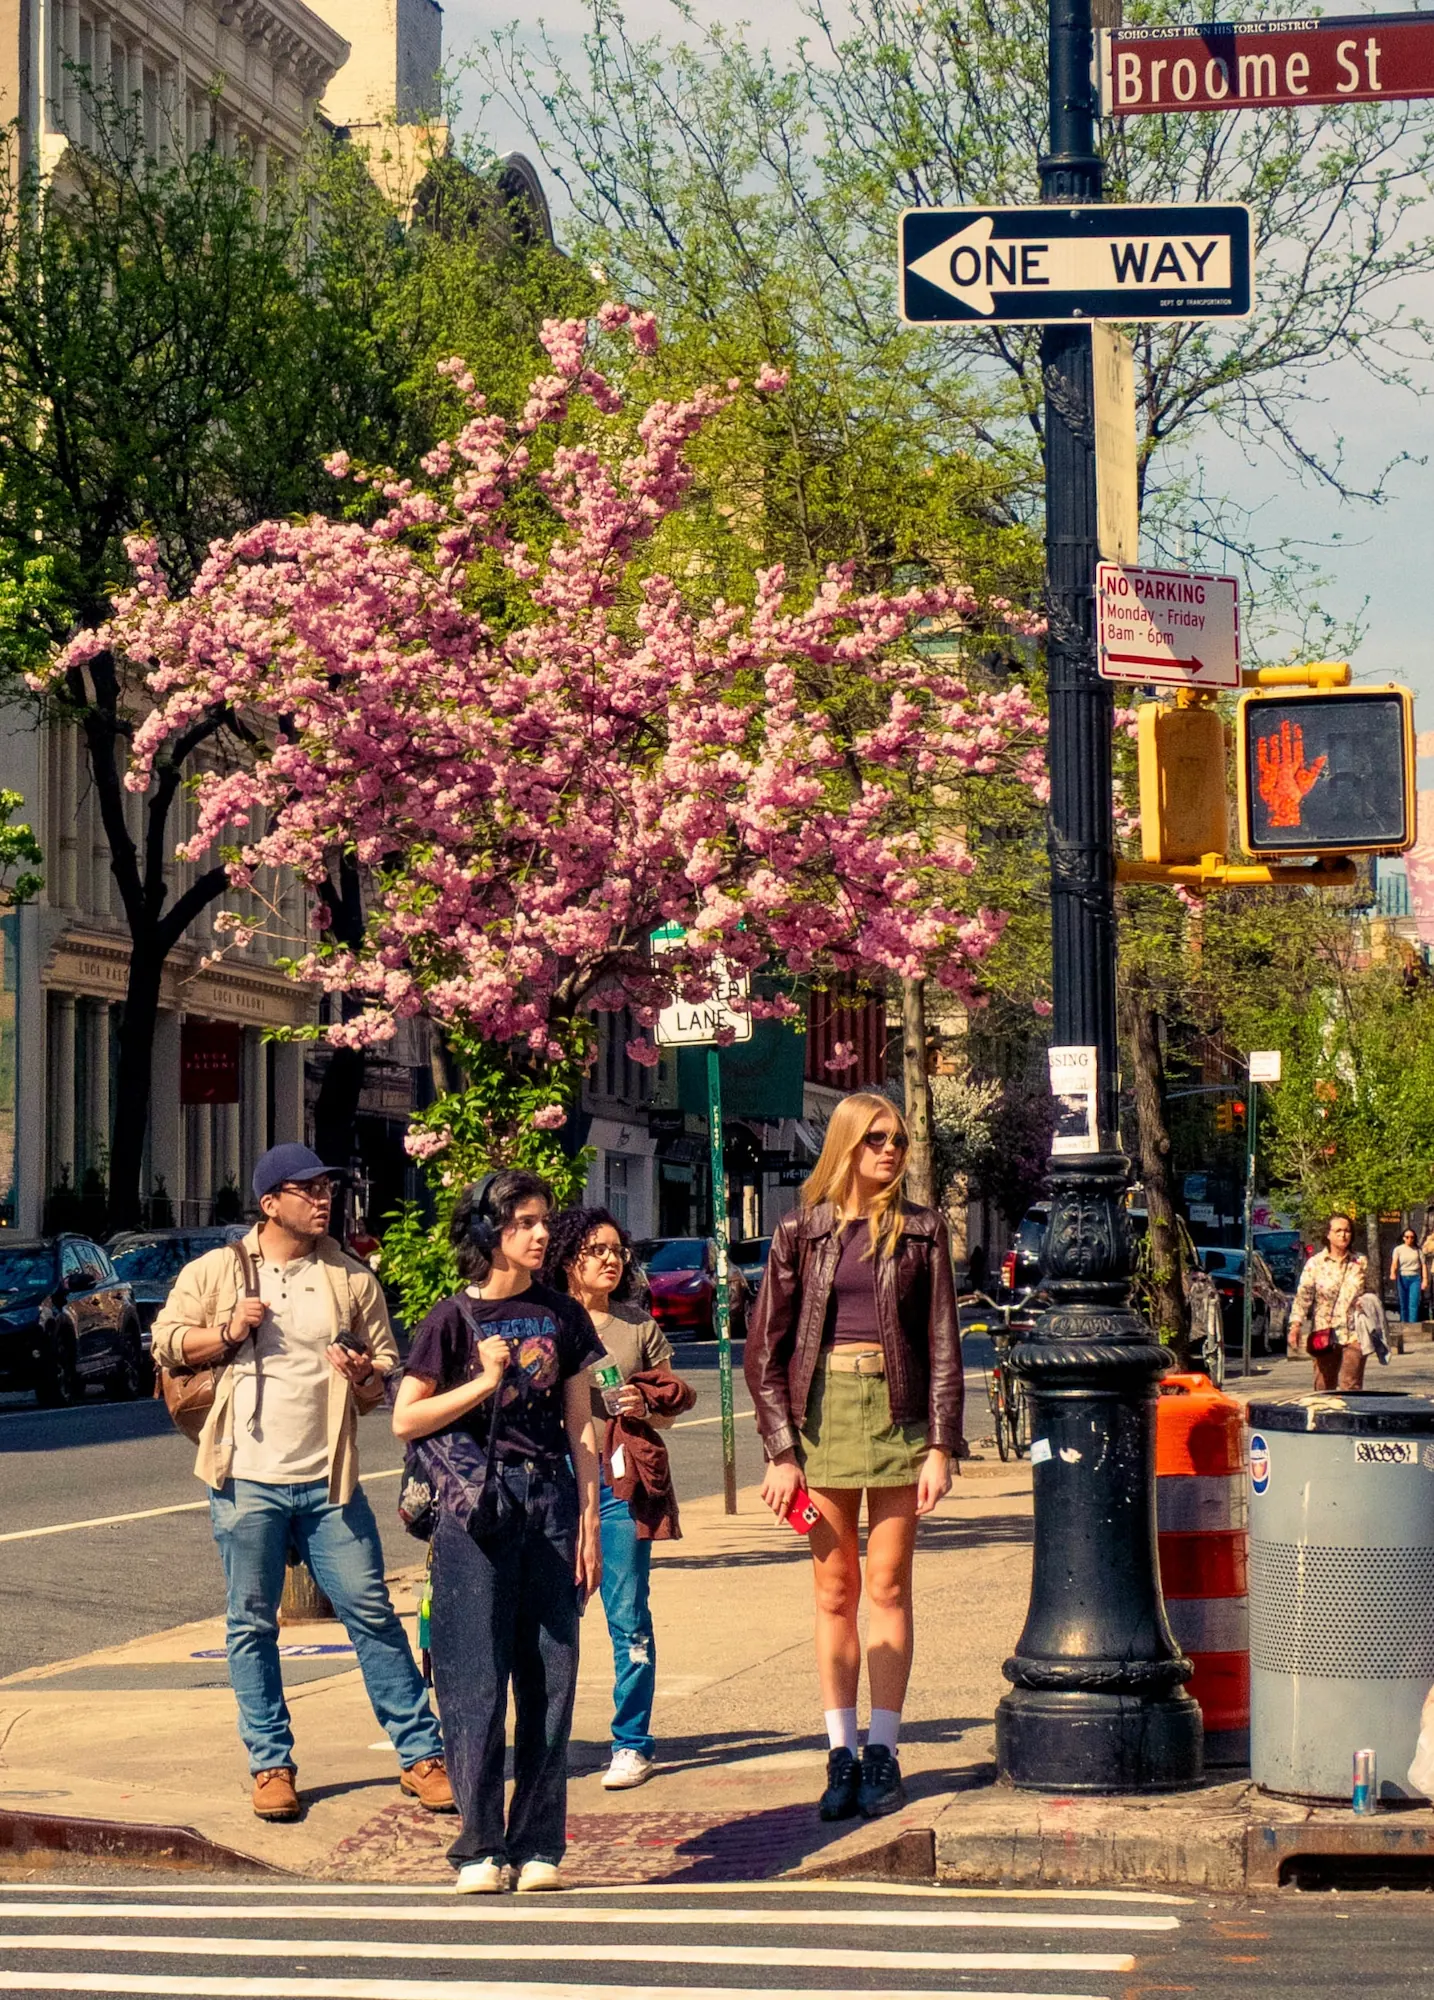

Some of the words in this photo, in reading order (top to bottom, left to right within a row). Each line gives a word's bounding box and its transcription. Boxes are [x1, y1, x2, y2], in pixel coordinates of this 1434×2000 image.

[1118, 28, 1180, 40] SOHO-CAST
[1184, 25, 1211, 36] IRON
[1214, 23, 1266, 35] HISTORIC
[1269, 20, 1320, 32] DISTRICT
[1118, 51, 1310, 104] Broome
[1336, 38, 1382, 93] St
[950, 245, 1049, 287] ONE
[1110, 241, 1218, 283] WAY
[1176, 299, 1184, 307] OF
[1186, 298, 1232, 306] TRANSPORTATION
[1107, 576, 1128, 596] NO
[1134, 578, 1206, 604] PARKING
[1107, 603, 1155, 626] Monday
[1167, 608, 1206, 631] Friday
[1107, 623, 1134, 641] 8am
[1147, 627, 1174, 646] 6pm
[676, 1008, 727, 1031] LANE
[480, 1316, 557, 1338] RIZONA
